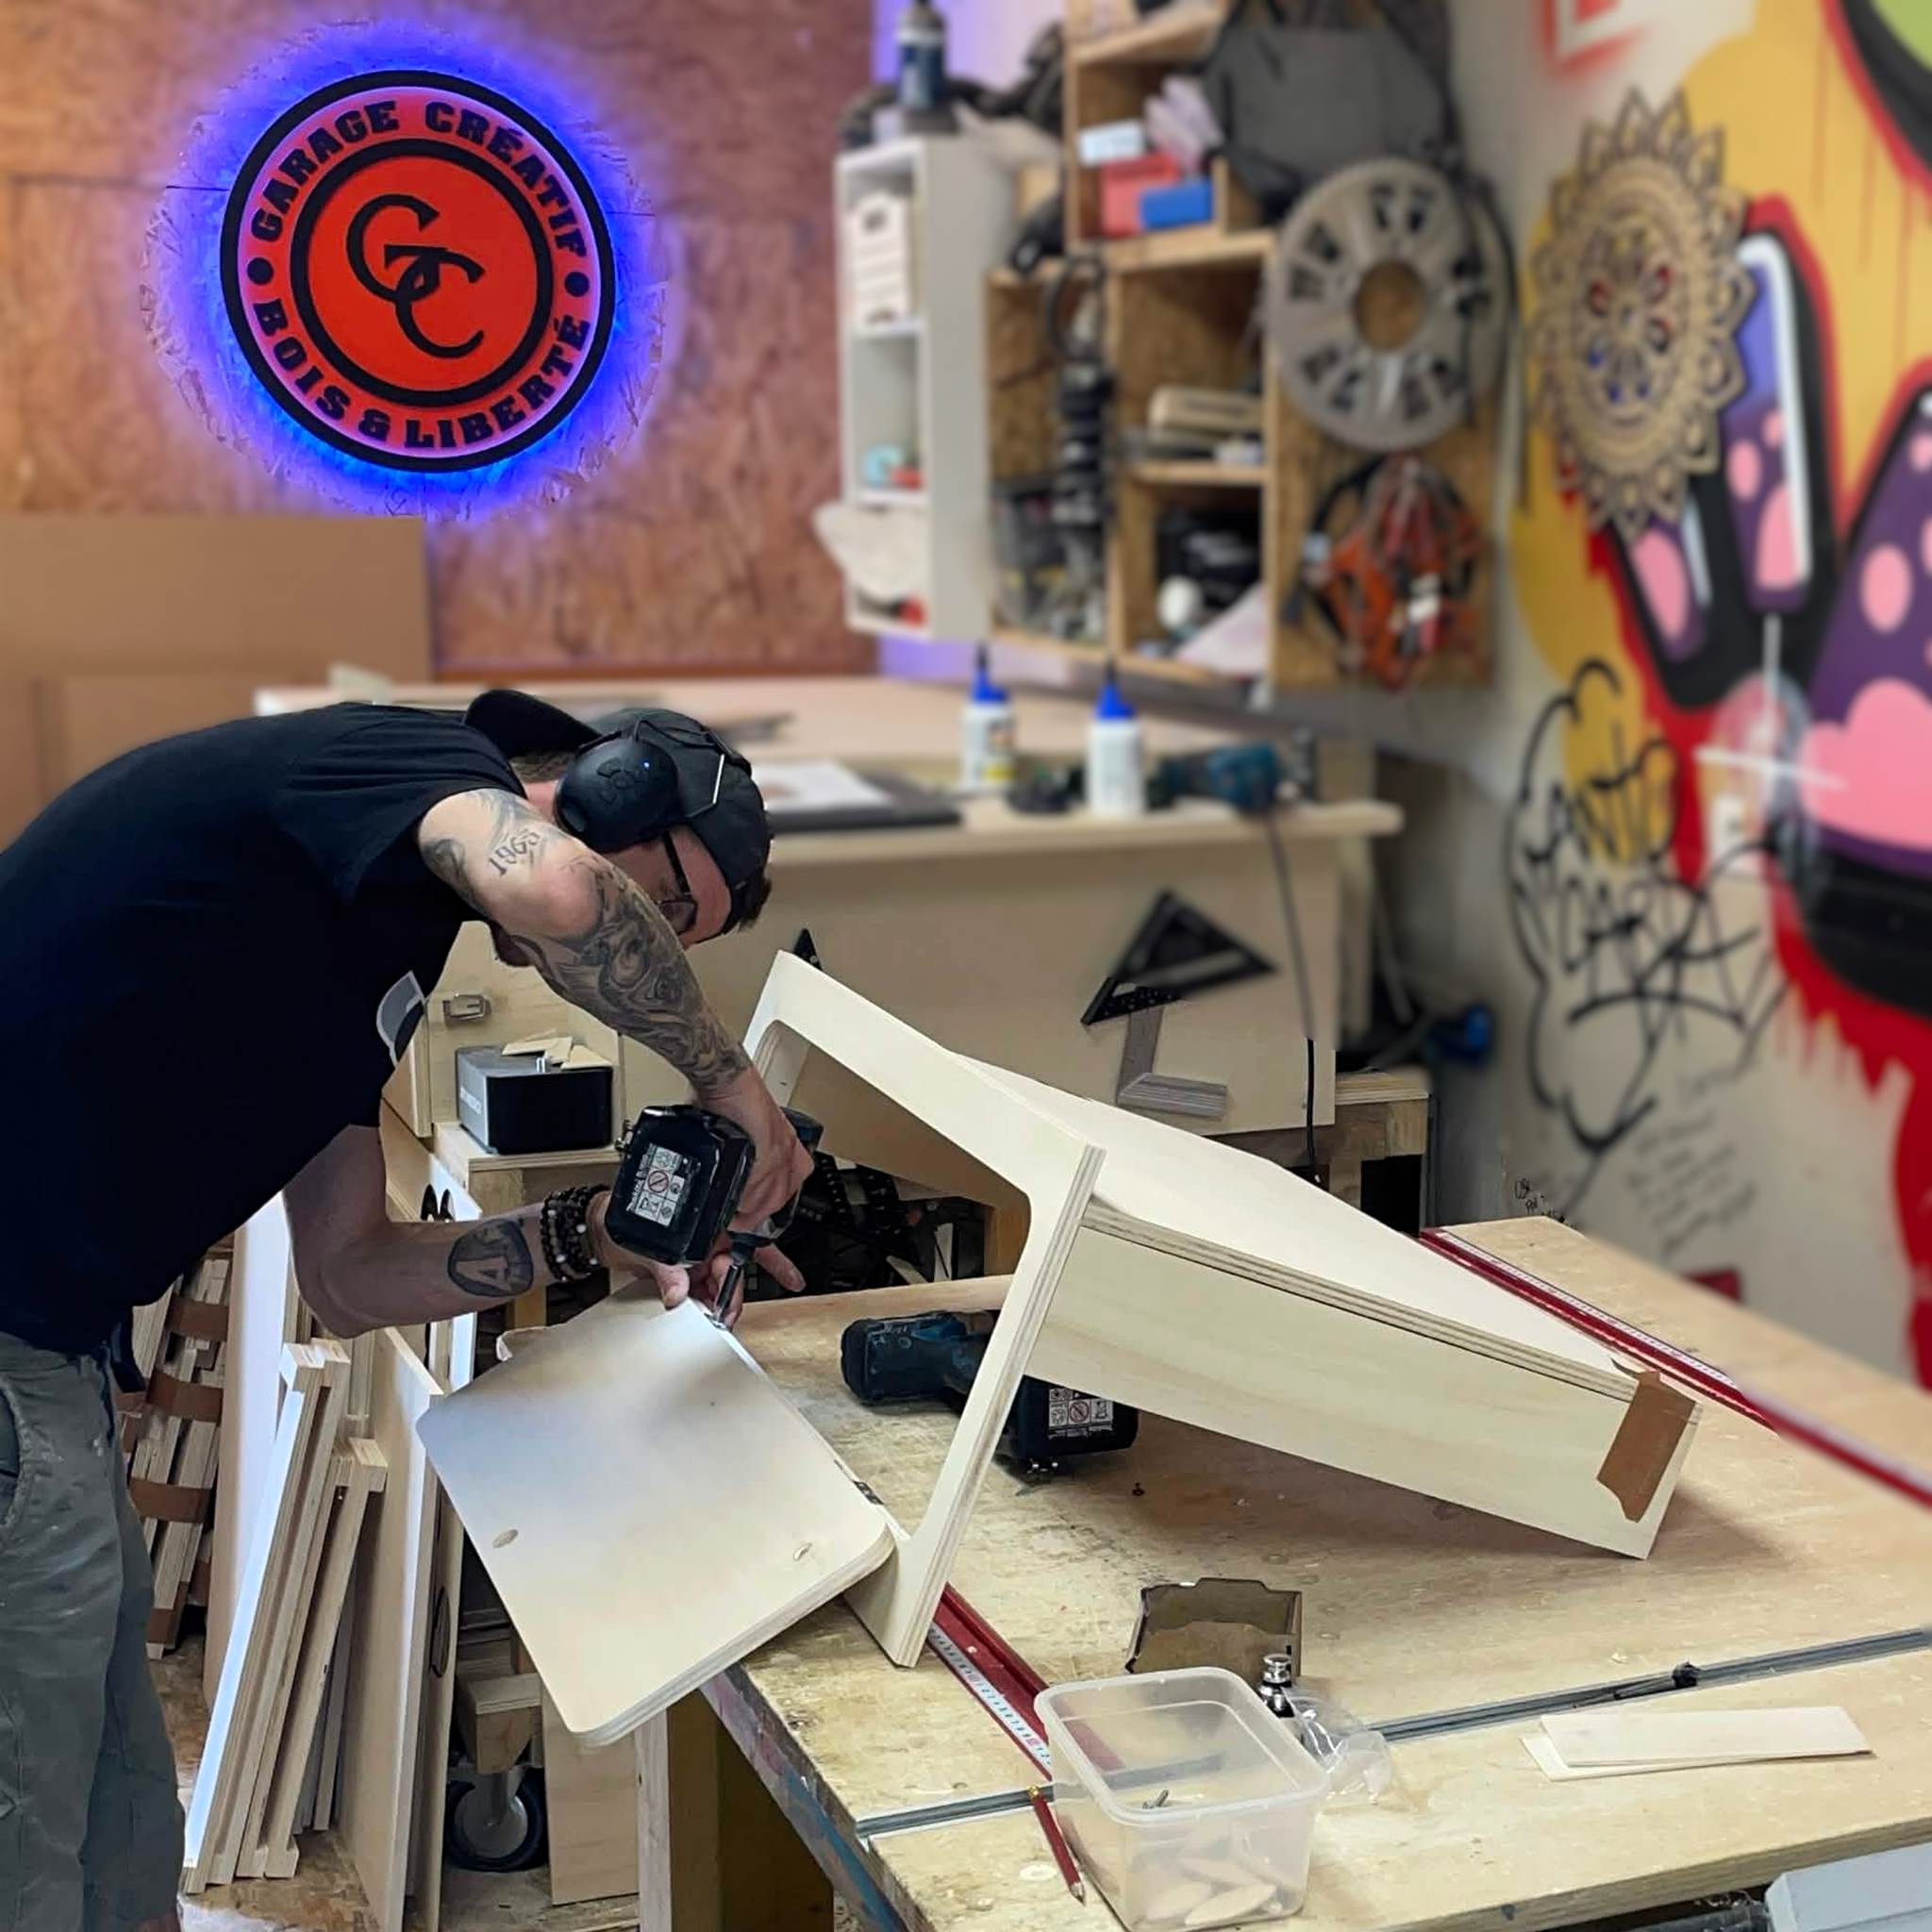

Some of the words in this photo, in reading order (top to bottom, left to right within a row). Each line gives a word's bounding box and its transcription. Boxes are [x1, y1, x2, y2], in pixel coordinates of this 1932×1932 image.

[250, 100, 400, 242] GARAGE
[425, 101, 588, 258] CRÉATIF
[345, 192, 486, 359] GC
[253, 298, 351, 421] BOIS
[358, 408, 391, 442] &
[404, 315, 591, 449] LIBERTÉ
